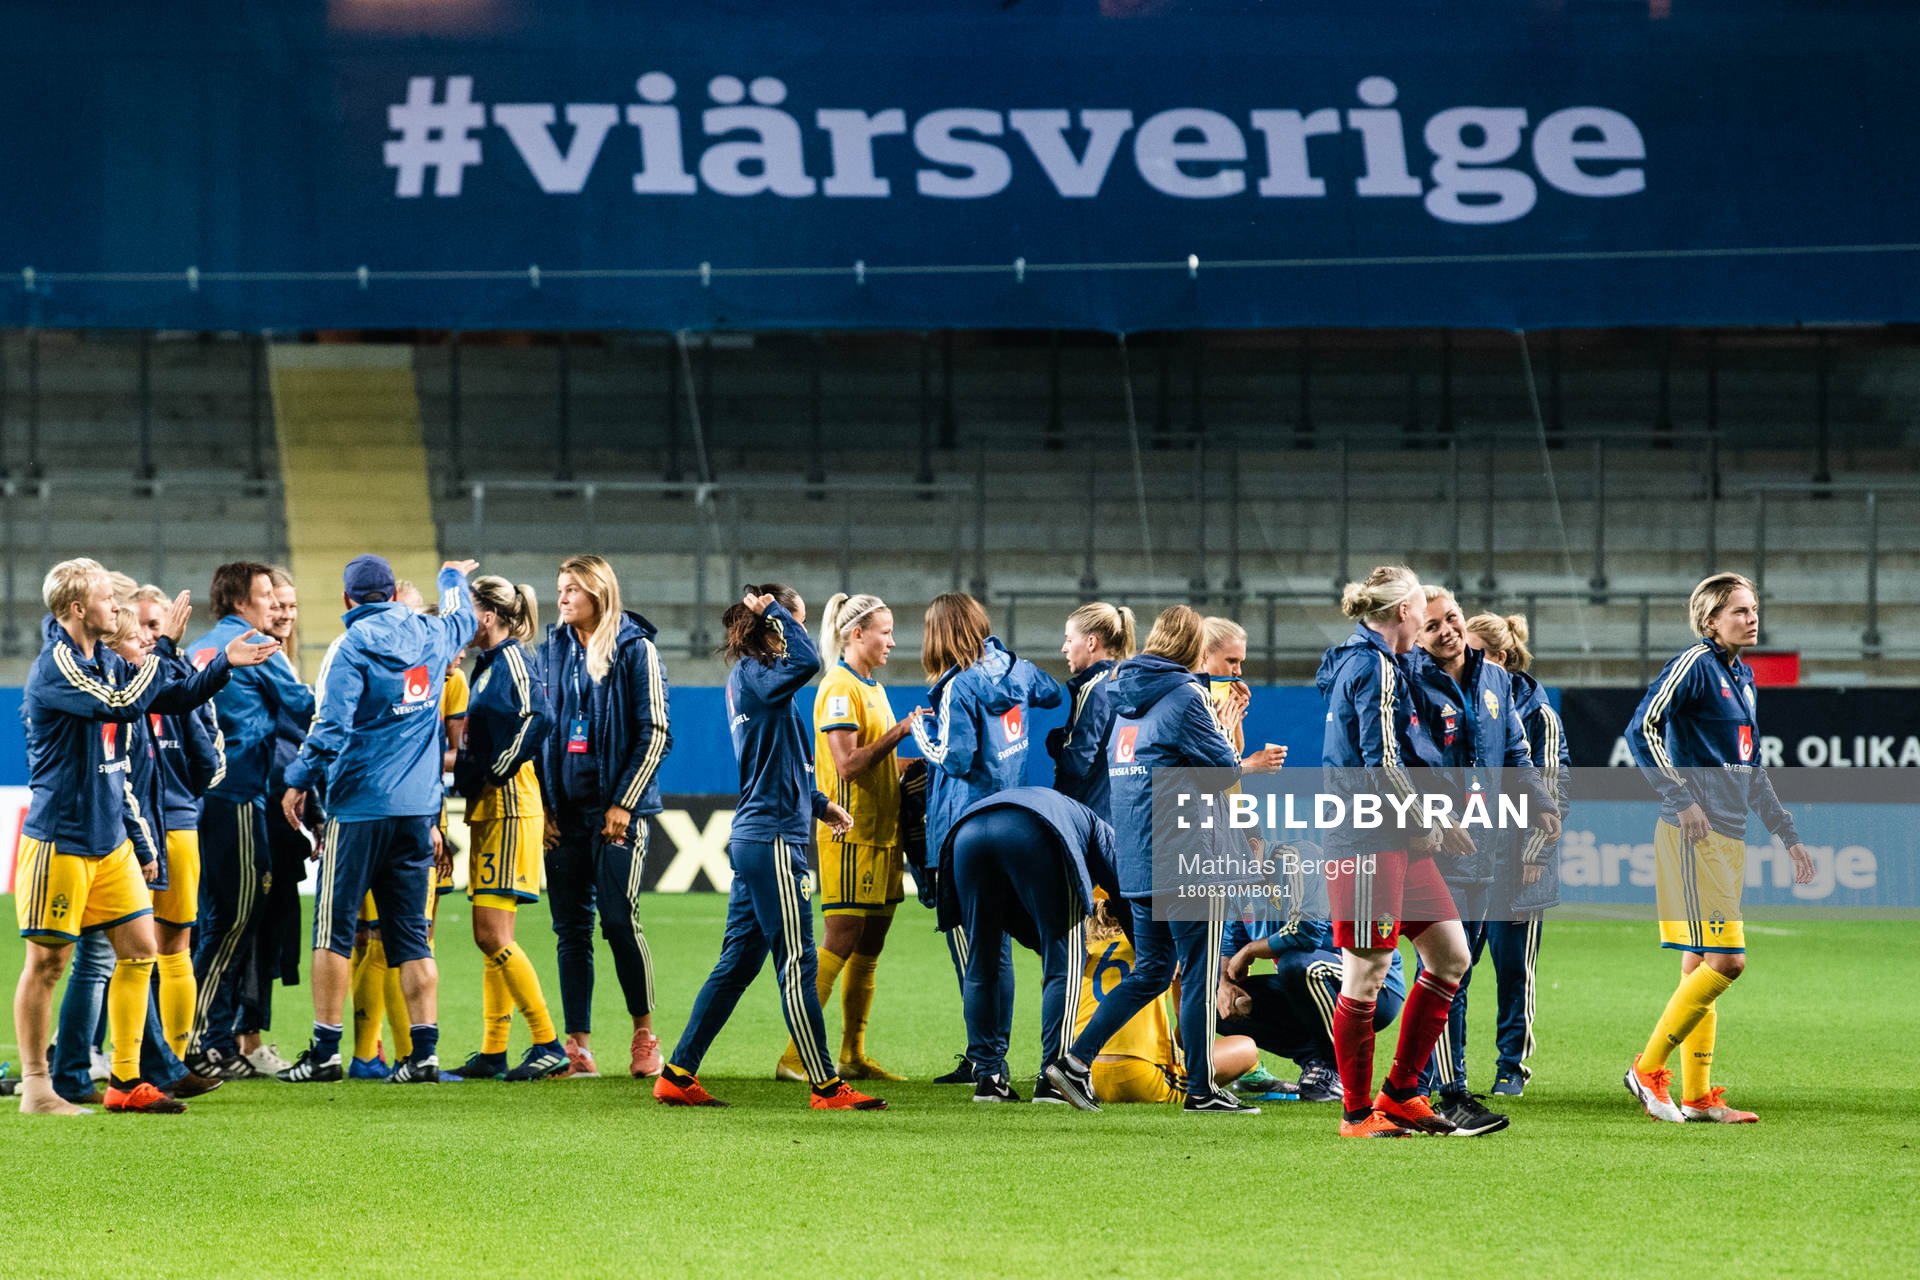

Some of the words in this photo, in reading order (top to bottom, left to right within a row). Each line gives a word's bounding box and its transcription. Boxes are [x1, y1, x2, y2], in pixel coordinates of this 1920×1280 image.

[383, 71, 1647, 225] #viärsverige
[1797, 735, 1920, 767] OLIKA
[1130, 765, 1148, 776] SPEL
[480, 852, 496, 885] 3
[1092, 941, 1132, 1003] 6
